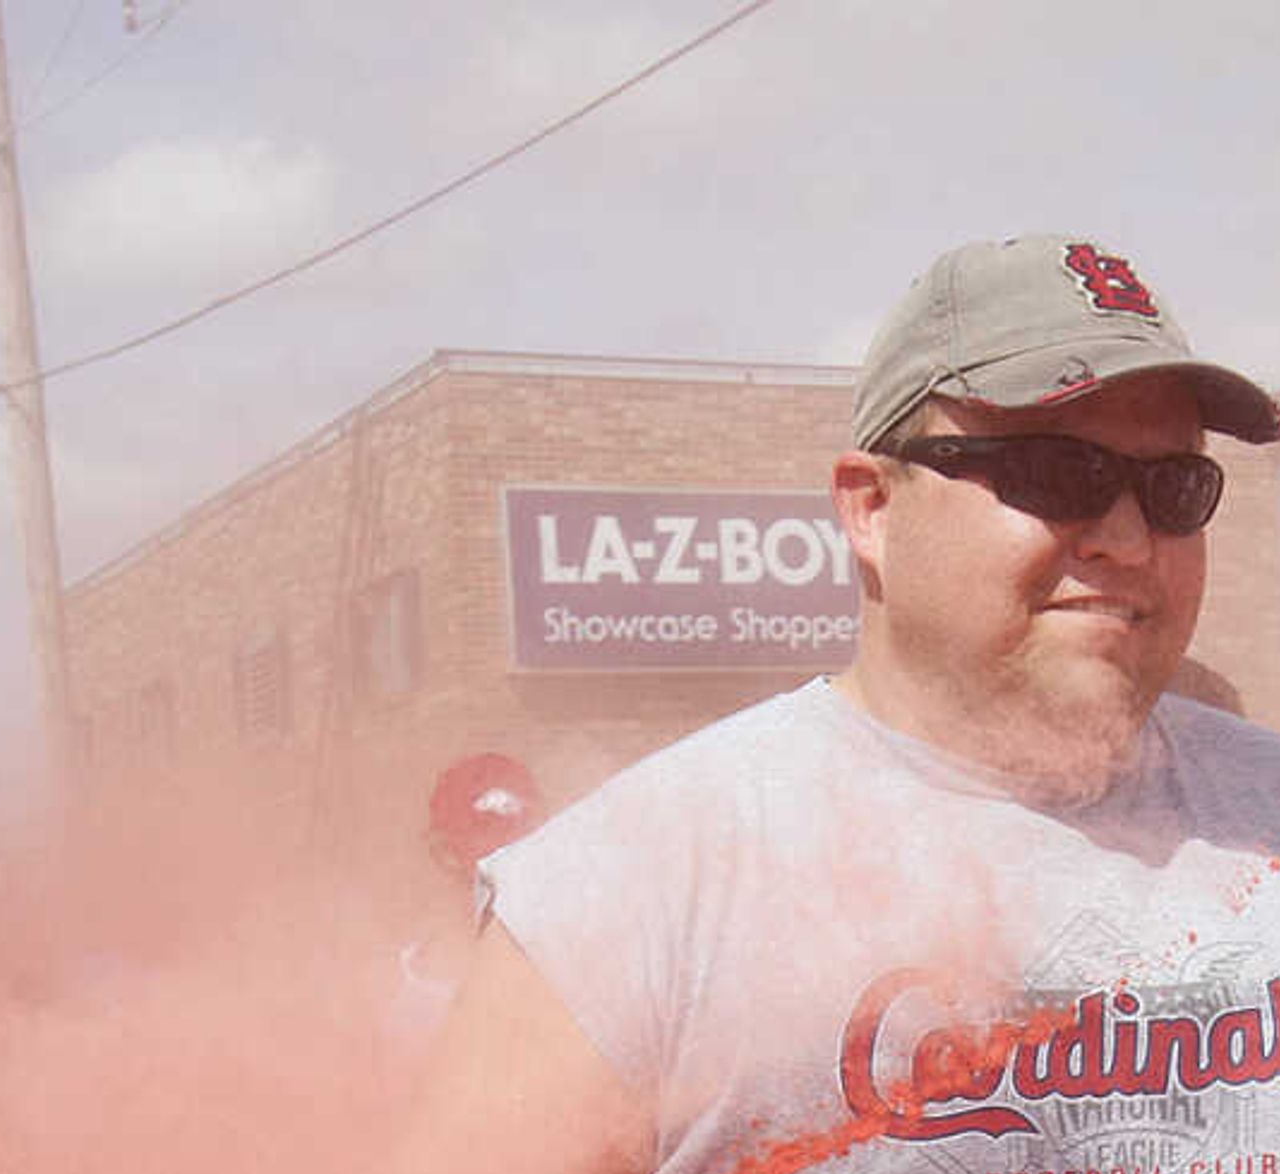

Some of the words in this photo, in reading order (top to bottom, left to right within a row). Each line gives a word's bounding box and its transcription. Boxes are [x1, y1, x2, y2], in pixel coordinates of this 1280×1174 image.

[537, 514, 852, 586] LA-Z-BOY
[543, 606, 718, 643] Showcase
[729, 607, 860, 650] Shoppe
